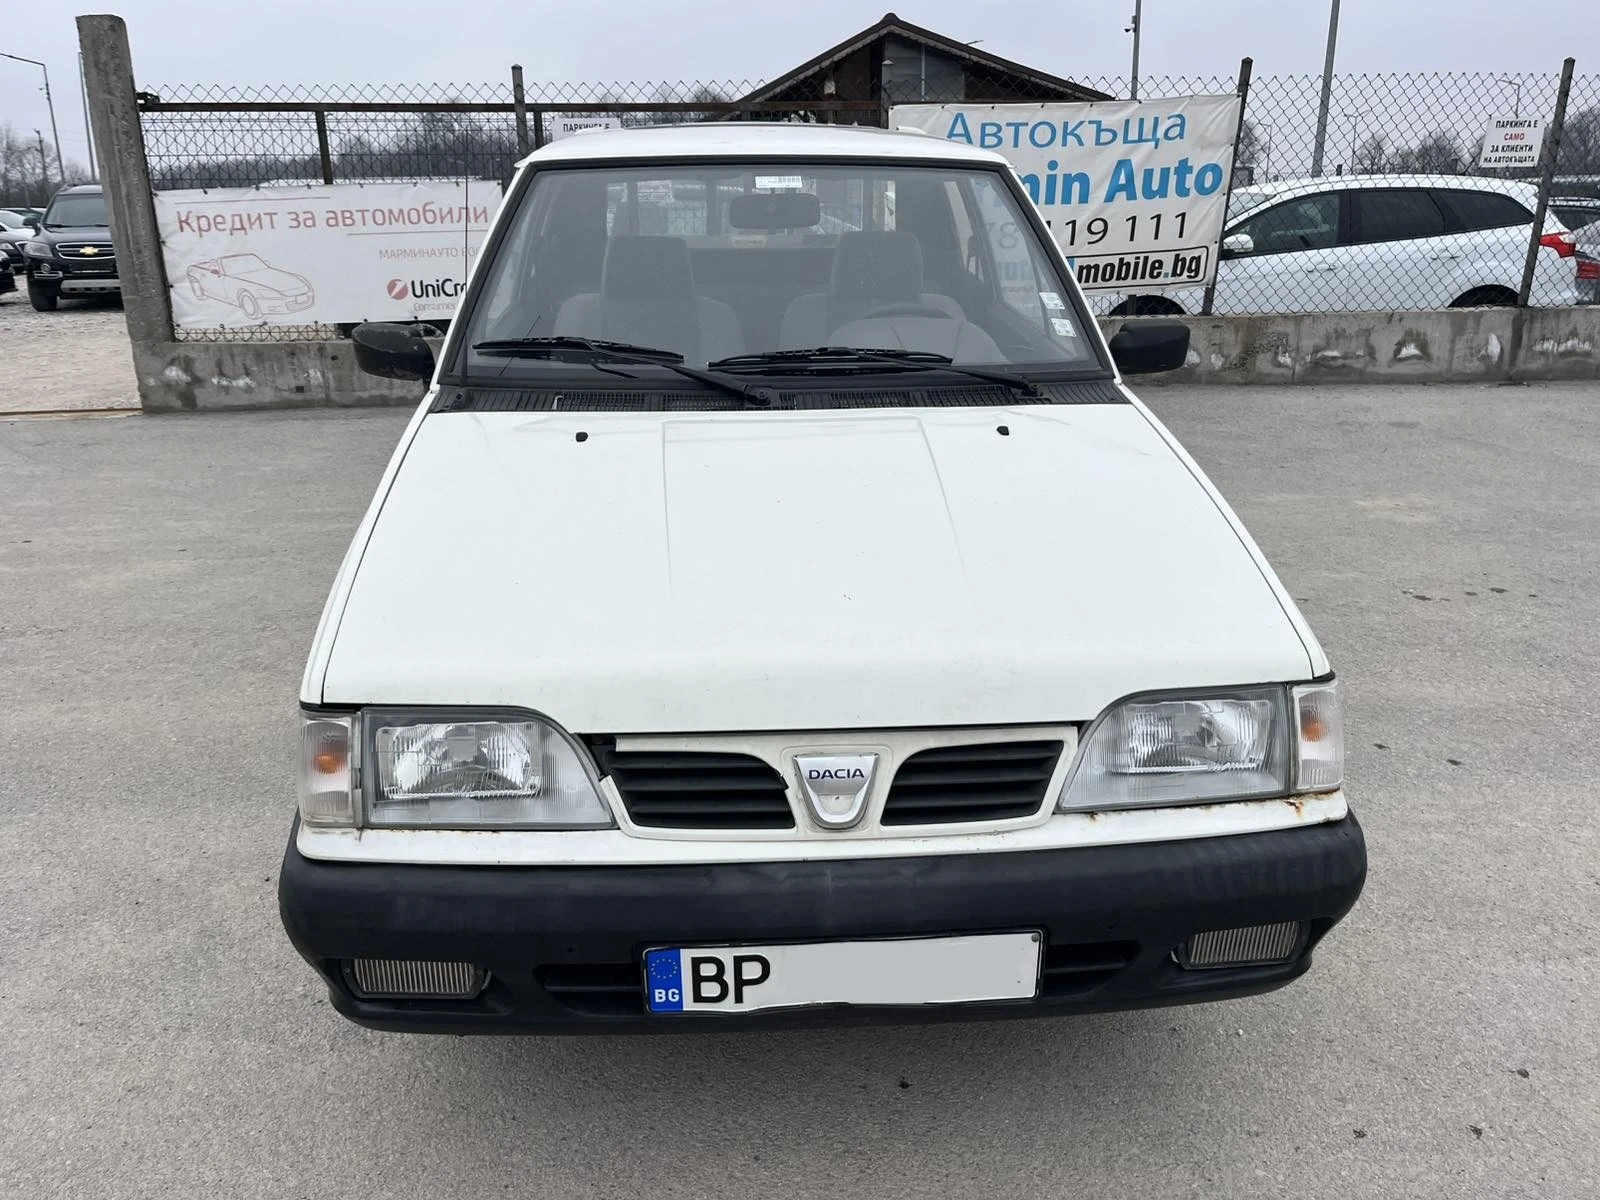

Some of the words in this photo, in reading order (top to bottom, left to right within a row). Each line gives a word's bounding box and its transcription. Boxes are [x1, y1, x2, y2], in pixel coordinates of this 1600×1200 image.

[946, 112, 1186, 149] Автокъща
[1496, 120, 1532, 128] ПАРКИНГА
[1533, 120, 1538, 128] Е
[1504, 132, 1525, 140] САМО
[1490, 144, 1499, 153] ЗА
[1501, 144, 1534, 152] КЛИЕНТИ
[1483, 156, 1492, 164] НА
[1493, 156, 1535, 164] АВТОКЪЩАТА
[1104, 157, 1223, 204] Auto
[176, 210, 278, 238] Кредит
[287, 209, 317, 229] за
[325, 200, 489, 228] автомобили
[1125, 211, 1187, 242] 111
[379, 246, 458, 259] МАРМИНАУТО
[1077, 253, 1202, 284] mobile.bg
[808, 768, 865, 780] DACIA
[691, 954, 771, 1004] BP
[654, 988, 680, 1003] BG
